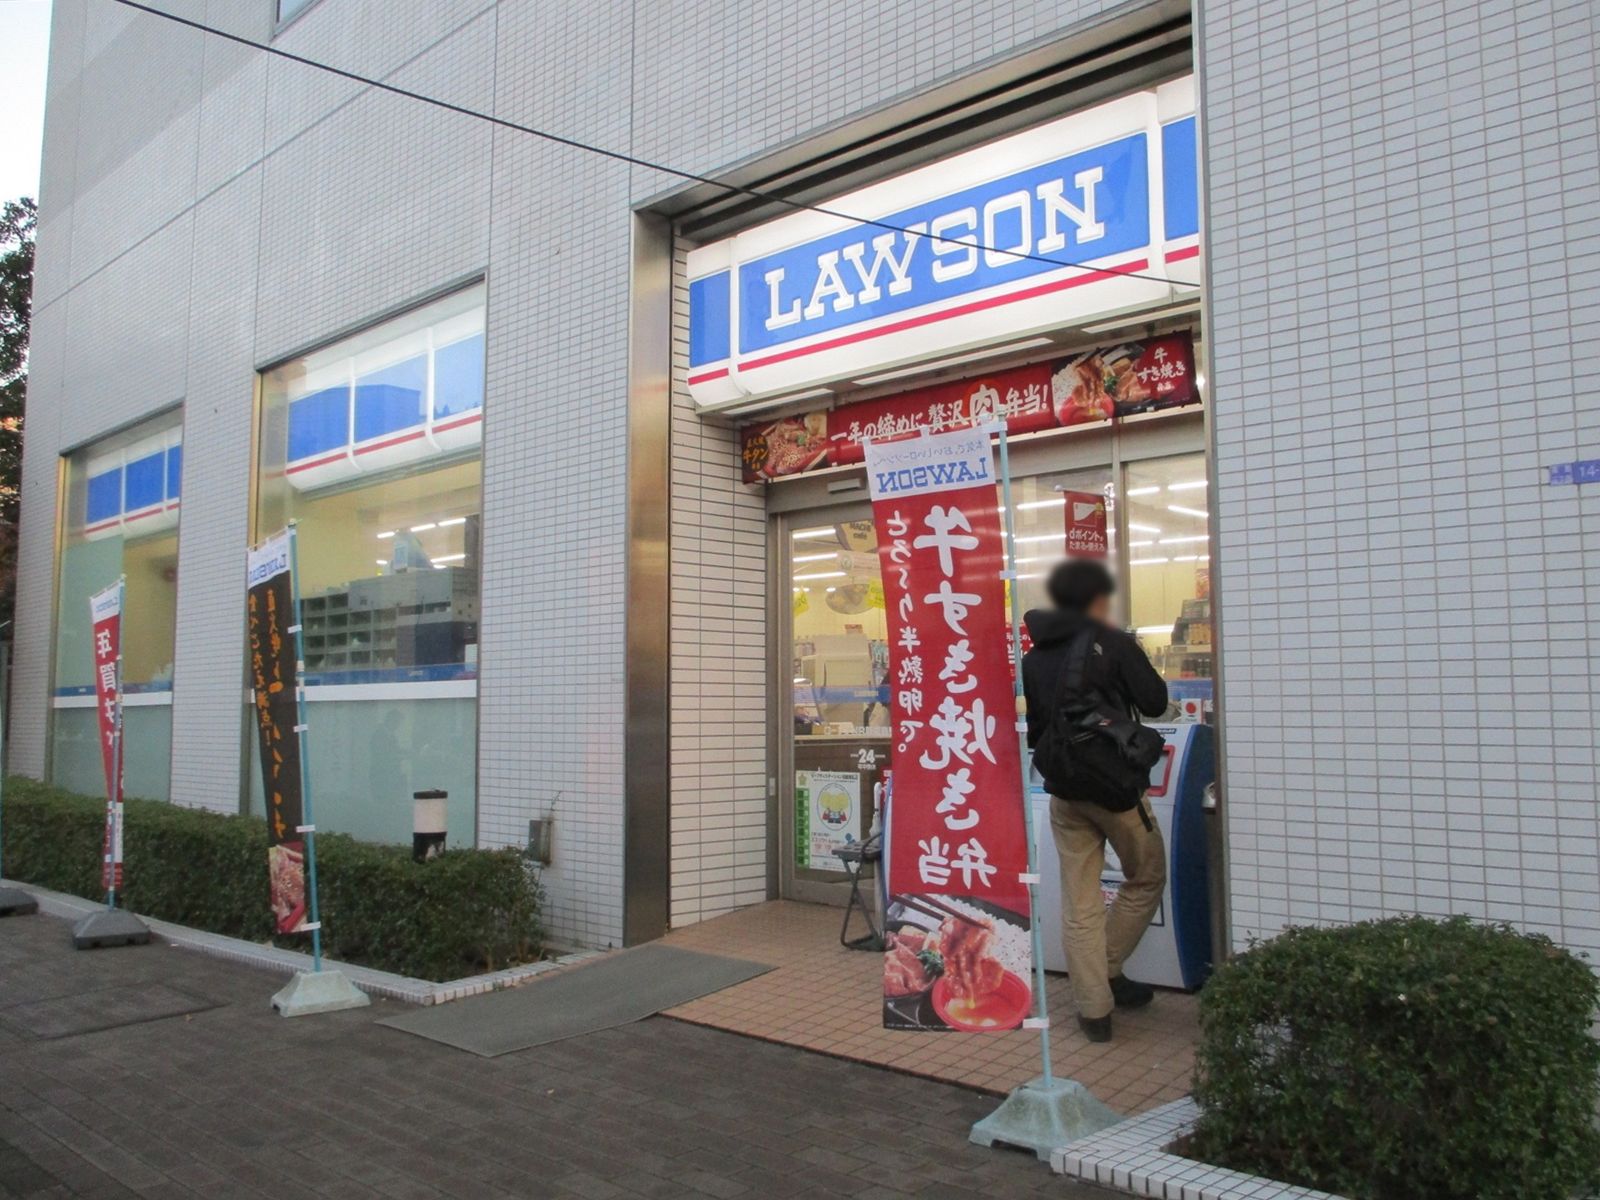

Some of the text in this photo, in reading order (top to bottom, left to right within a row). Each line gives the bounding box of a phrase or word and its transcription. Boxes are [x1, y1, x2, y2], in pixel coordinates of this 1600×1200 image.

[764, 165, 1105, 331] LAWSON
[1154, 346, 1168, 364] 牛
[1137, 361, 1186, 384] すき焼き
[858, 747, 876, 763] 24
